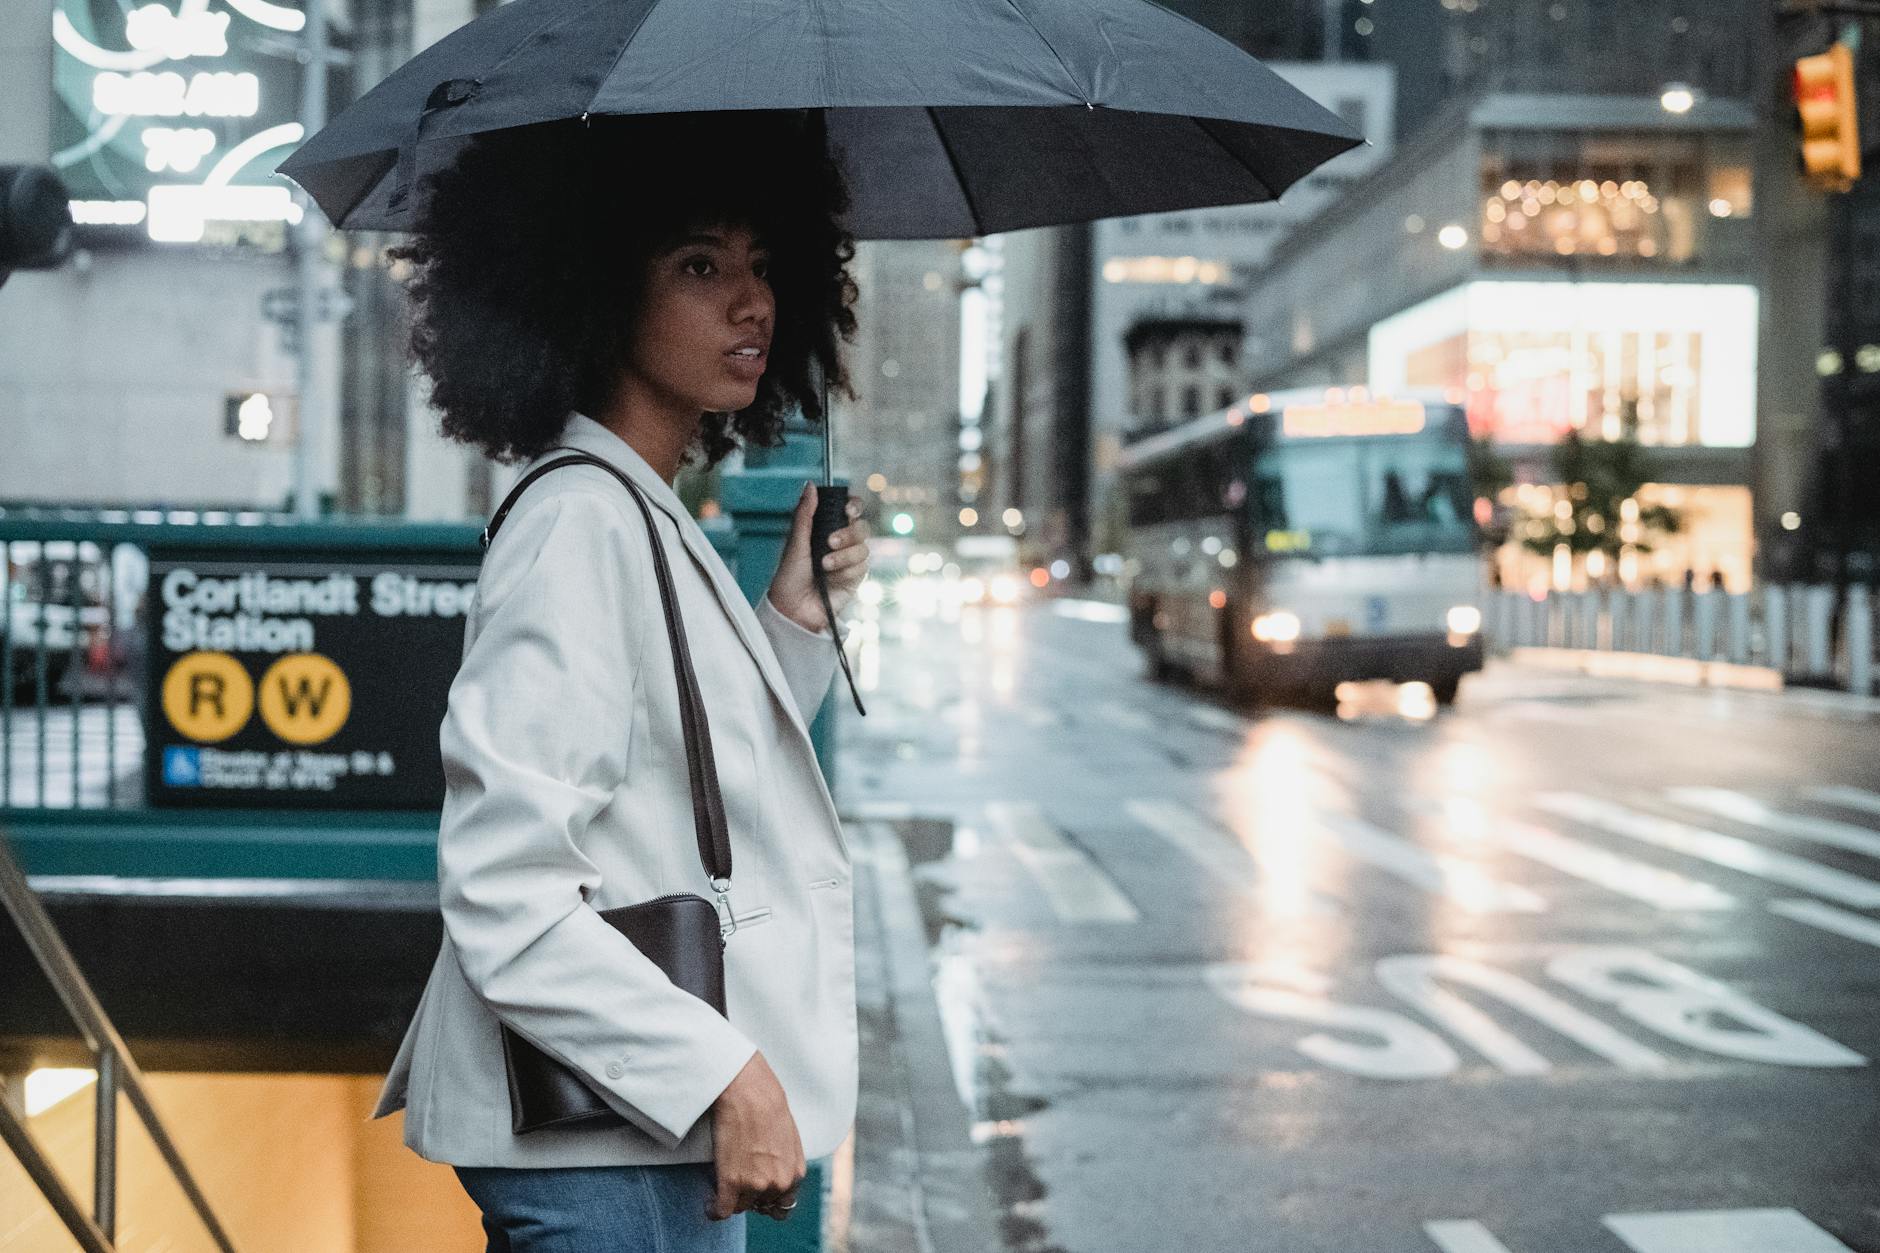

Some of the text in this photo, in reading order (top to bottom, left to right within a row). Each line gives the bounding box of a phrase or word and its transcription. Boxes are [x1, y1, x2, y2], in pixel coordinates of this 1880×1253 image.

[162, 569, 359, 617] Cortlandt
[162, 605, 315, 651] Station
[188, 672, 333, 719] R W
[1204, 948, 1868, 1080] BUS
